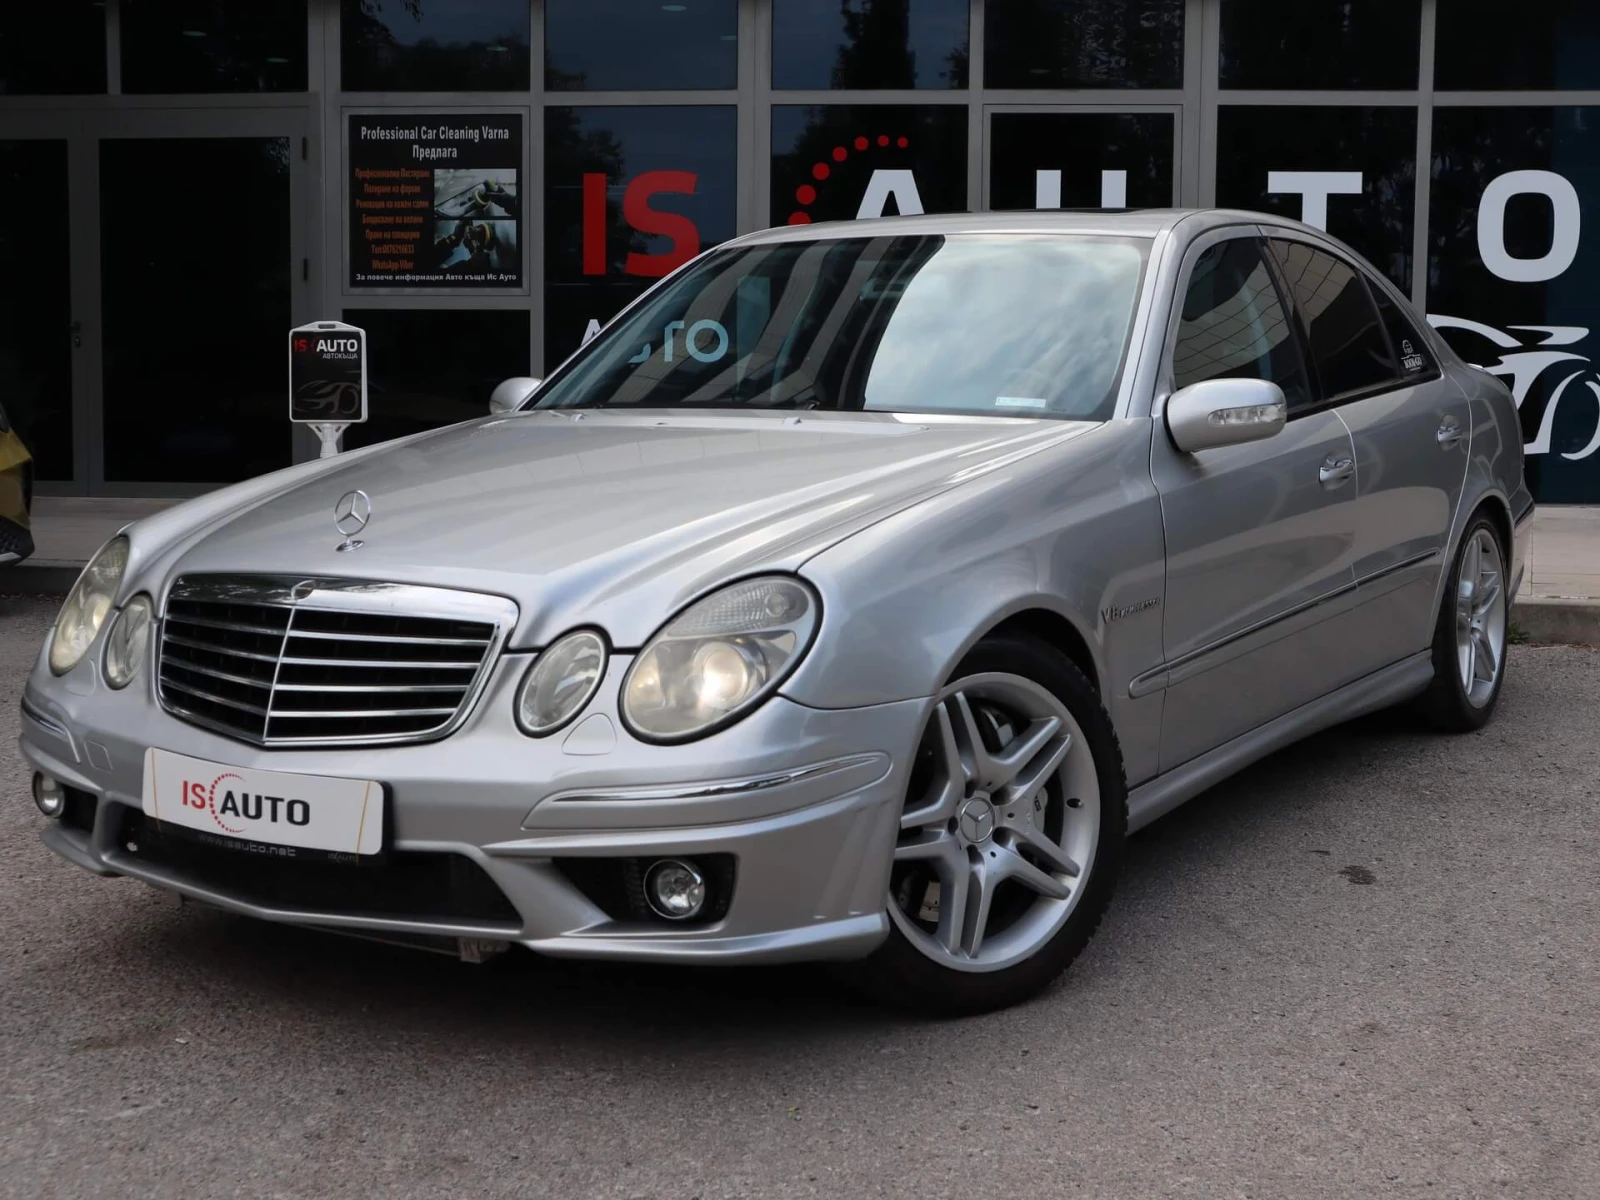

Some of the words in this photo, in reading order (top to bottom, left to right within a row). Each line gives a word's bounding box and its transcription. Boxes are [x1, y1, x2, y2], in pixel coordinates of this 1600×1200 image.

[361, 126, 418, 140] Professional
[421, 126, 437, 140] Car
[439, 126, 479, 143] Cleaning
[481, 126, 509, 140] Varna
[412, 144, 458, 161] Предлага
[583, 170, 700, 277] IS
[356, 273, 366, 281] За
[367, 274, 394, 282] повече
[395, 273, 444, 282] информация
[446, 273, 463, 281] Авто
[464, 274, 485, 282] къща
[487, 273, 497, 281] Ис
[499, 273, 517, 282] Ауто
[294, 338, 308, 352] IS
[316, 339, 358, 353] AUTO
[182, 780, 206, 810] IS
[220, 790, 311, 827] AUTO
